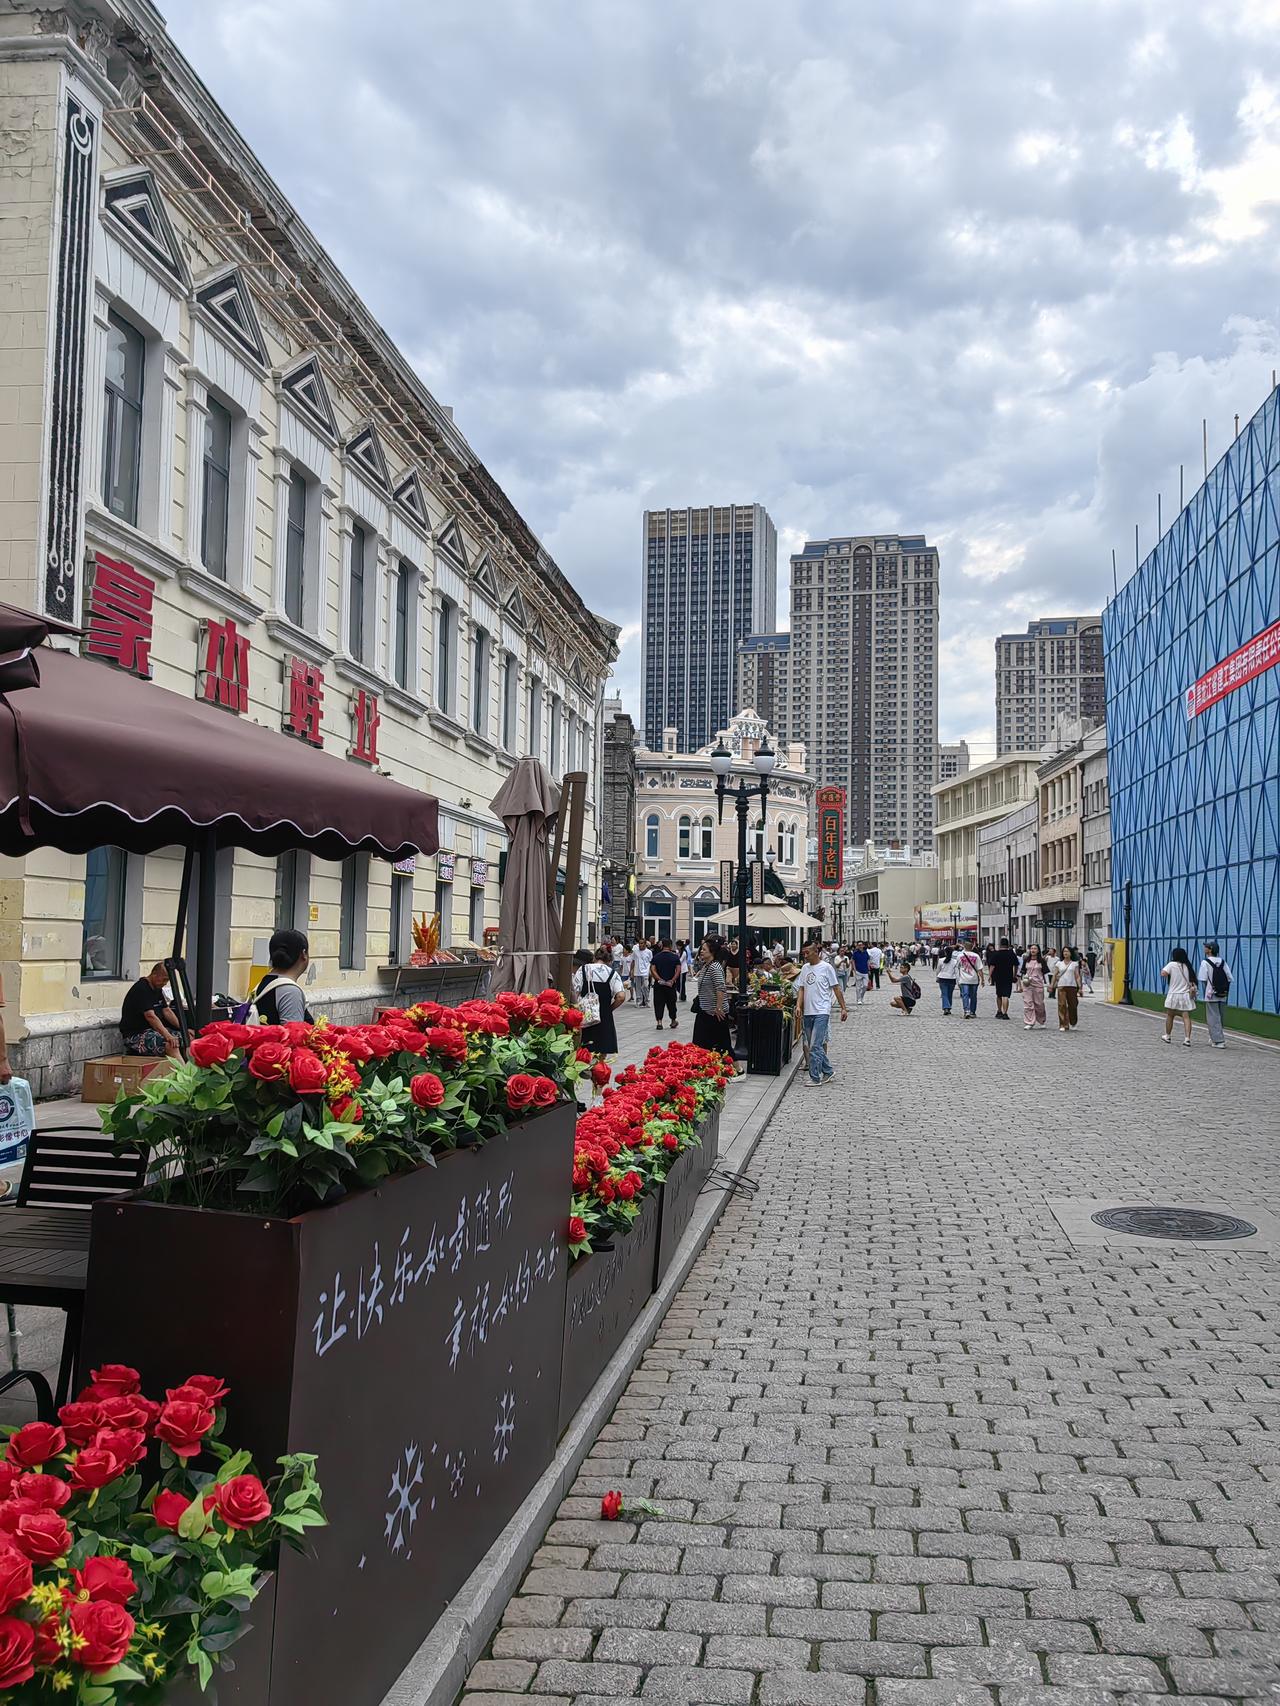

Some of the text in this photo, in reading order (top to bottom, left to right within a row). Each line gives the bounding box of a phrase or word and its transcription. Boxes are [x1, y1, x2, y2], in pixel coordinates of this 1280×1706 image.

[88, 551, 381, 765] 豪杰鞋业
[824, 816, 837, 879] 百年老店
[312, 1170, 515, 1357] 让快乐如影随形
